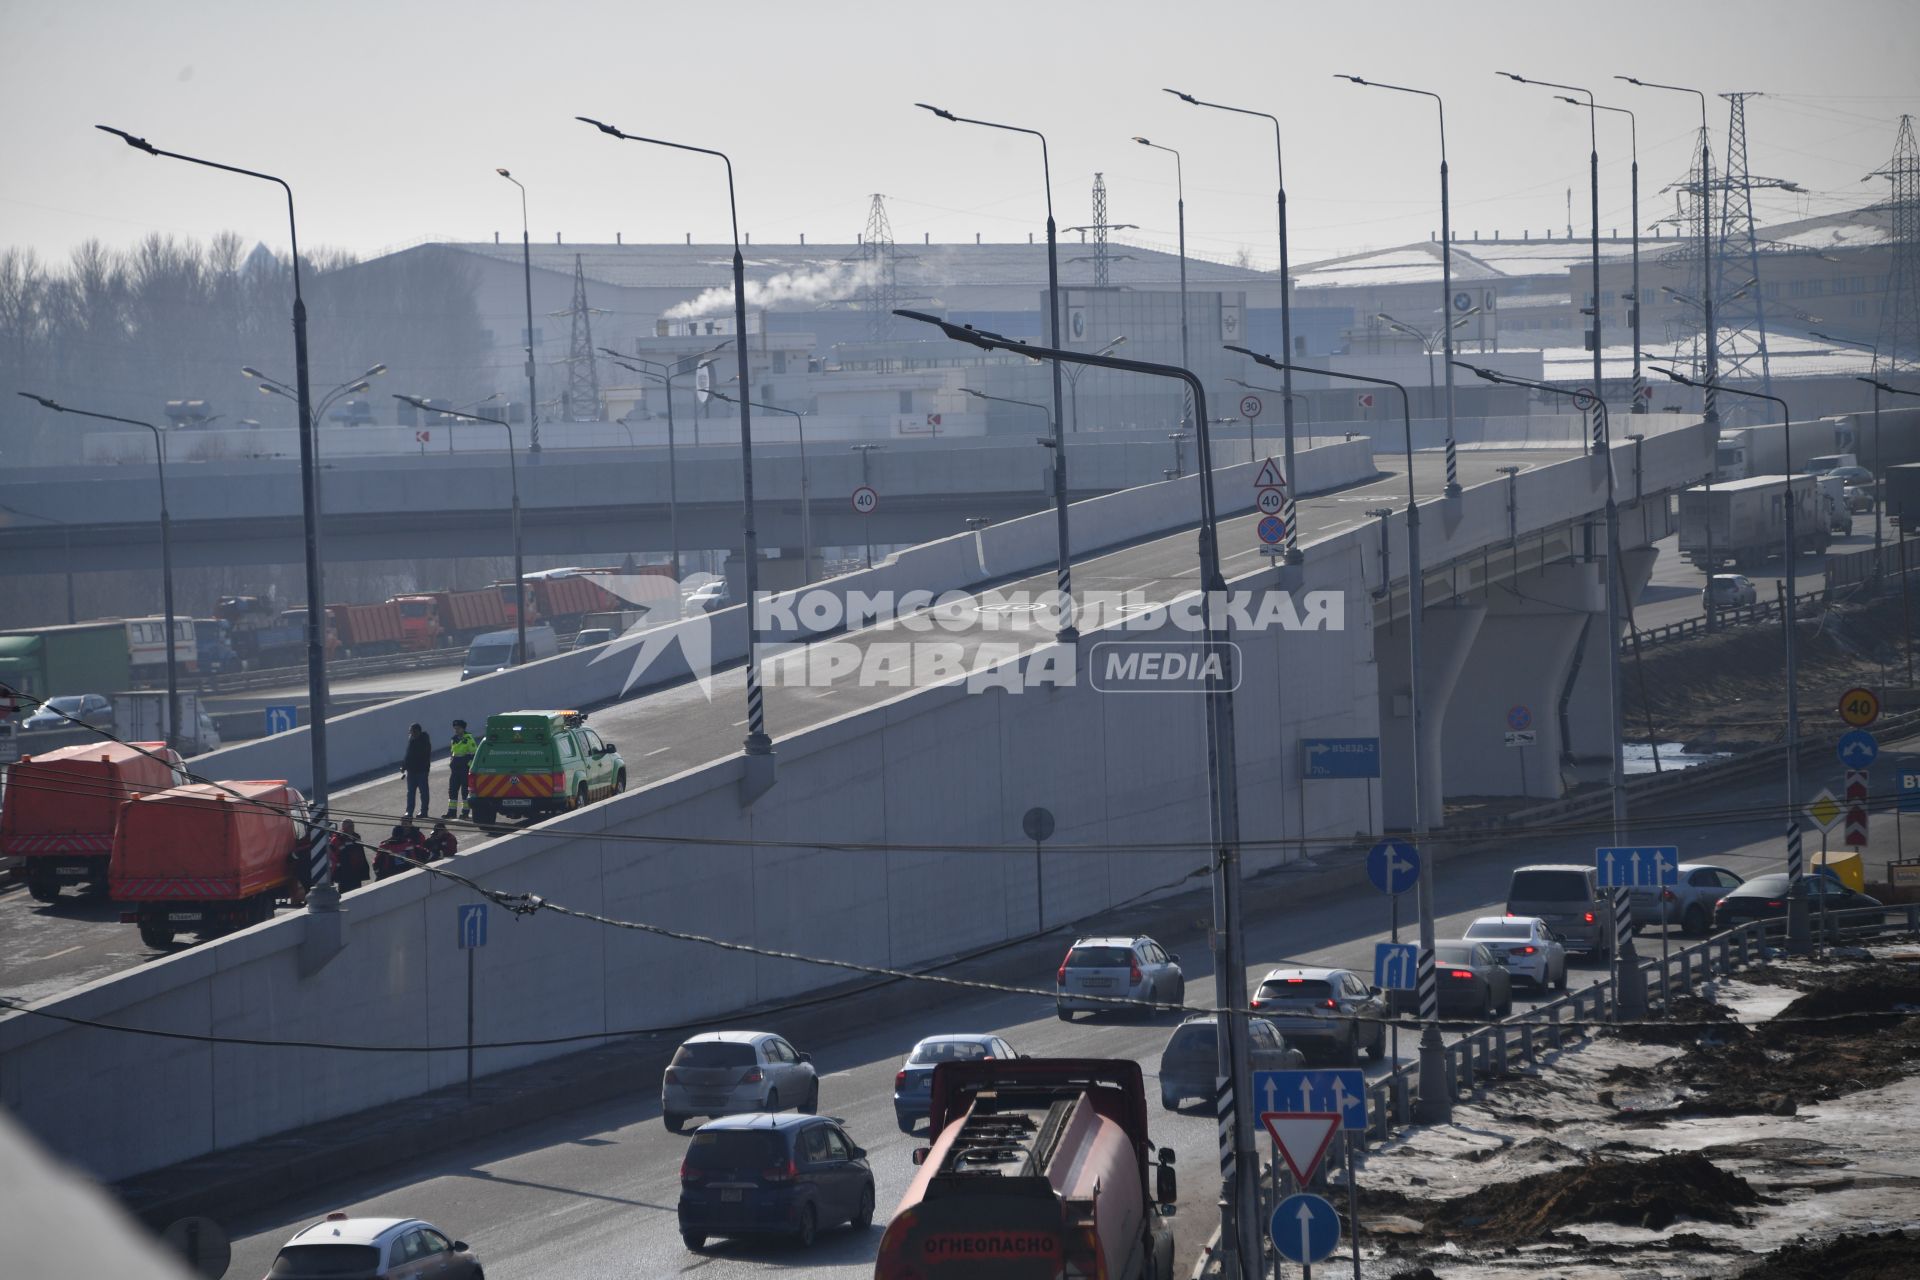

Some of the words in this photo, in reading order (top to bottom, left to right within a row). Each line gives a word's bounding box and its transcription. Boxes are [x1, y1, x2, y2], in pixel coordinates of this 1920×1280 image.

[1244, 401, 1258, 412] 30
[857, 494, 873, 506] 40
[1261, 495, 1279, 507] 40
[1846, 699, 1871, 715] 40
[924, 1237, 1054, 1253] ОГНЕОПАСНО
